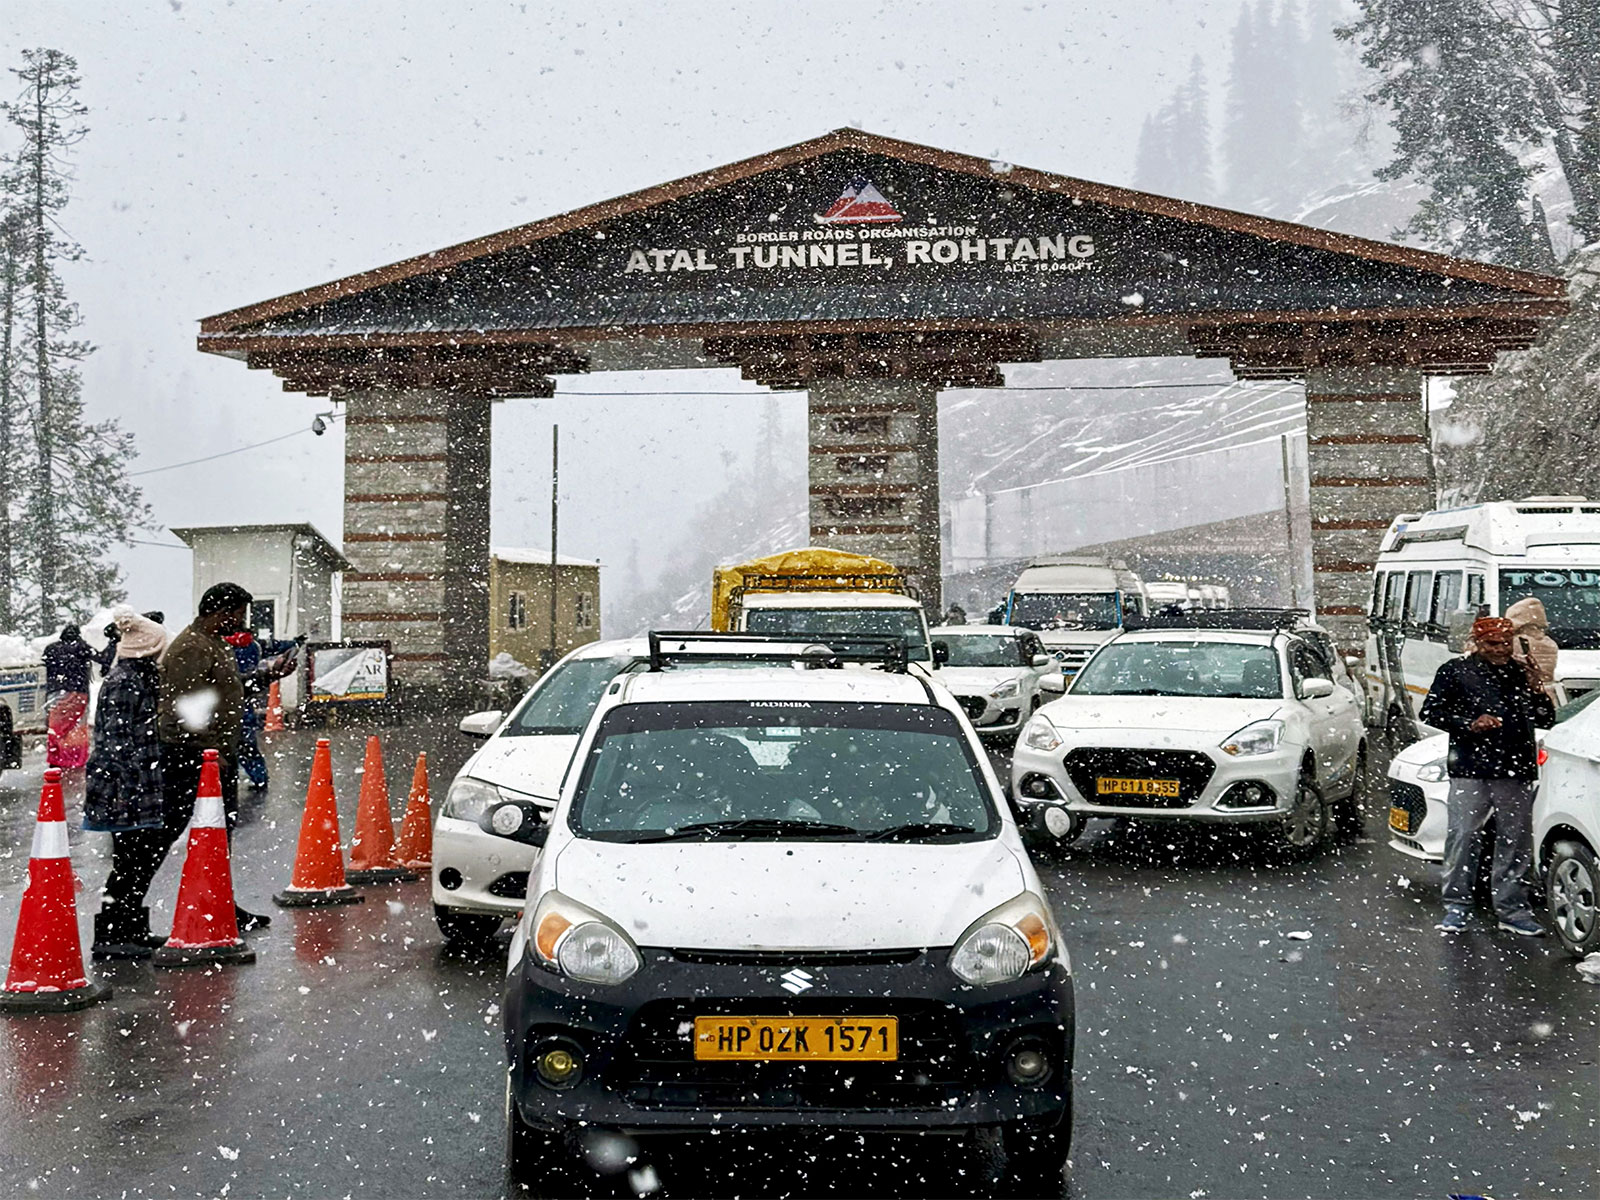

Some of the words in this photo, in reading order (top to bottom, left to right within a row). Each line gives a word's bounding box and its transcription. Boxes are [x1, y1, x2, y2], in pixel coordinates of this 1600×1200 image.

[737, 231, 798, 243] BORDER
[803, 229, 855, 241] ROADS
[860, 226, 977, 240] ORGANISATION
[624, 248, 717, 274] ATAL
[728, 242, 893, 270] TUNNEL,
[907, 235, 1095, 265] ROHTANG
[718, 1026, 752, 1052] HP
[759, 1026, 809, 1052] 02K
[825, 1026, 888, 1052] 1571
